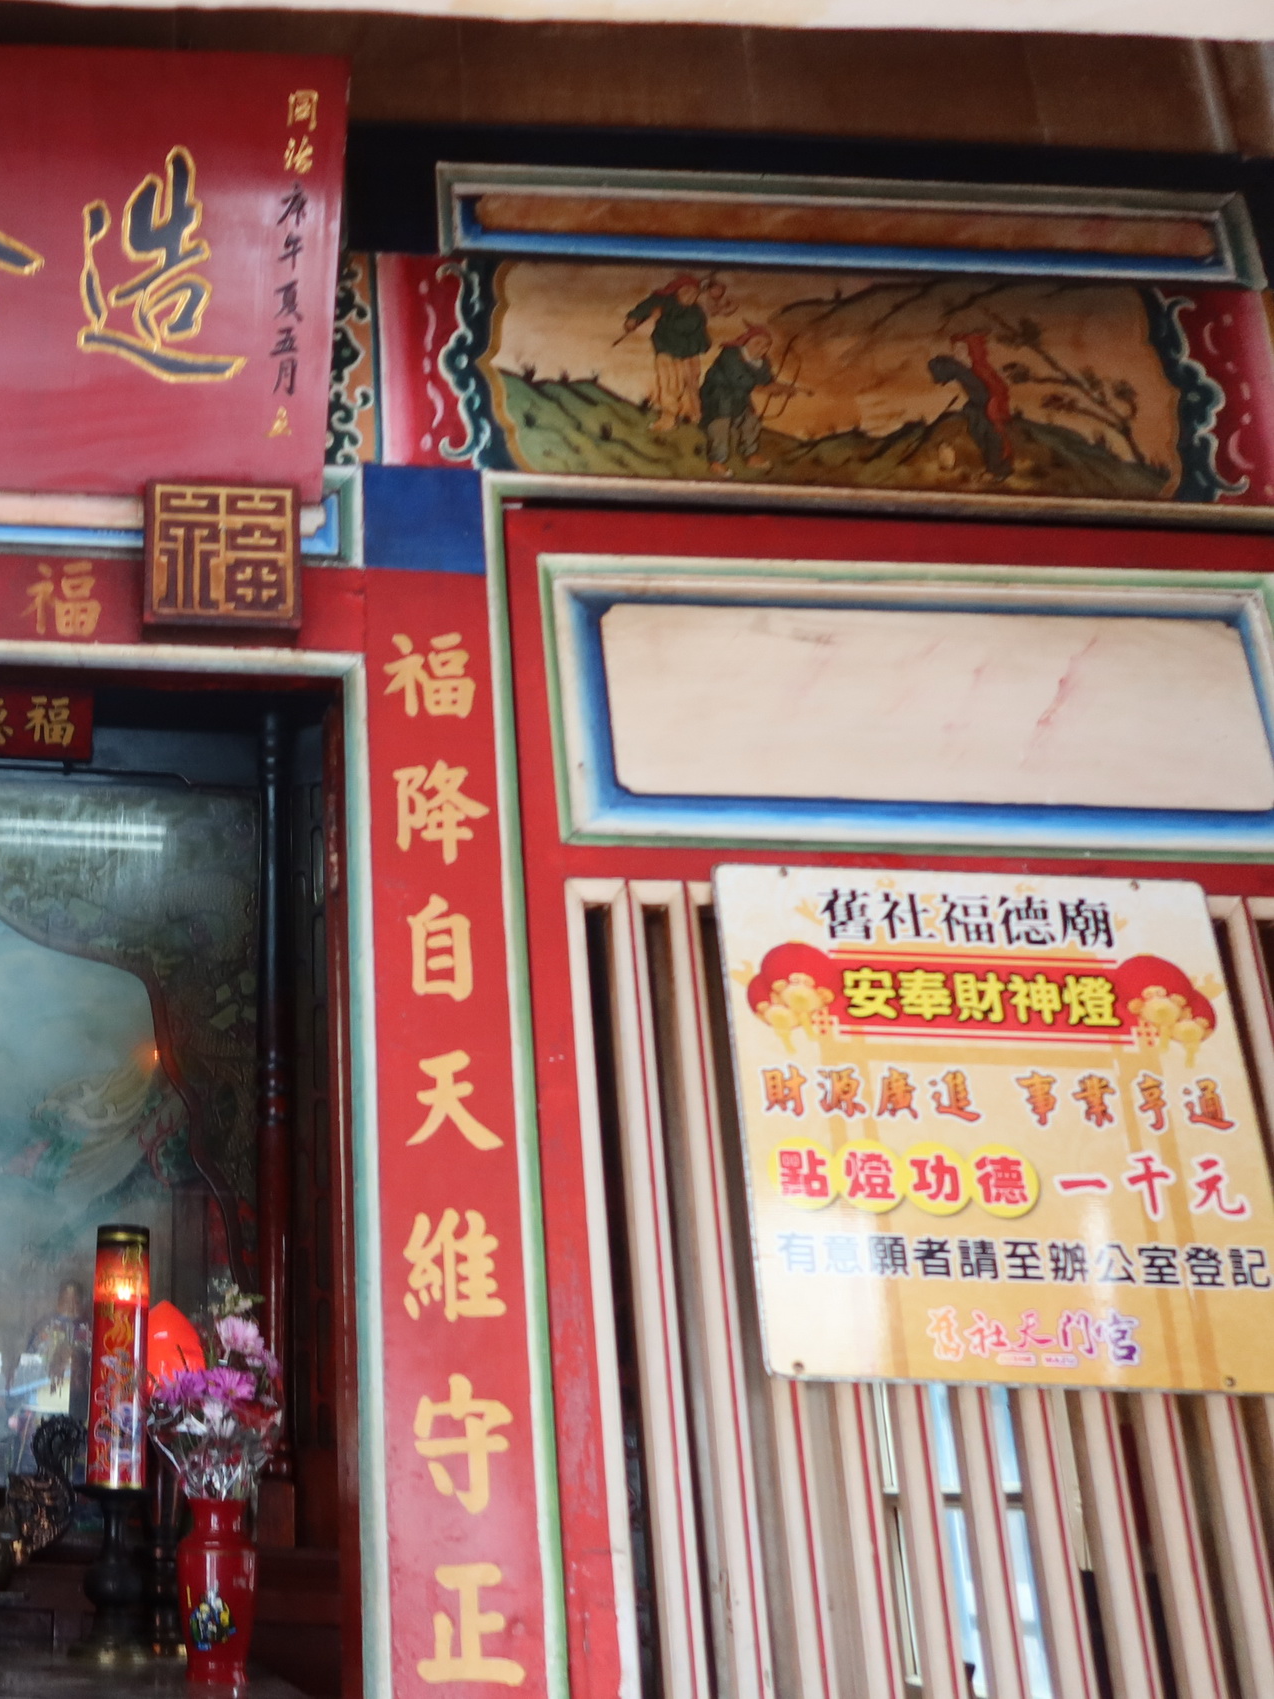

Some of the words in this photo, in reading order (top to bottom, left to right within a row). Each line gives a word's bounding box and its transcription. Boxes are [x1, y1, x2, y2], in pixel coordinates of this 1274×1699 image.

[818, 887, 1115, 950] 舊社福德廟
[842, 966, 1121, 1028] 安奉財神燈
[761, 1063, 983, 1124] 財源廣進
[1014, 1070, 1237, 1132] 事業亨通
[382, 631, 526, 1687] 福降自天維守正
[776, 1148, 1030, 1207] 點燈功德
[1055, 1156, 1248, 1218] 一千元
